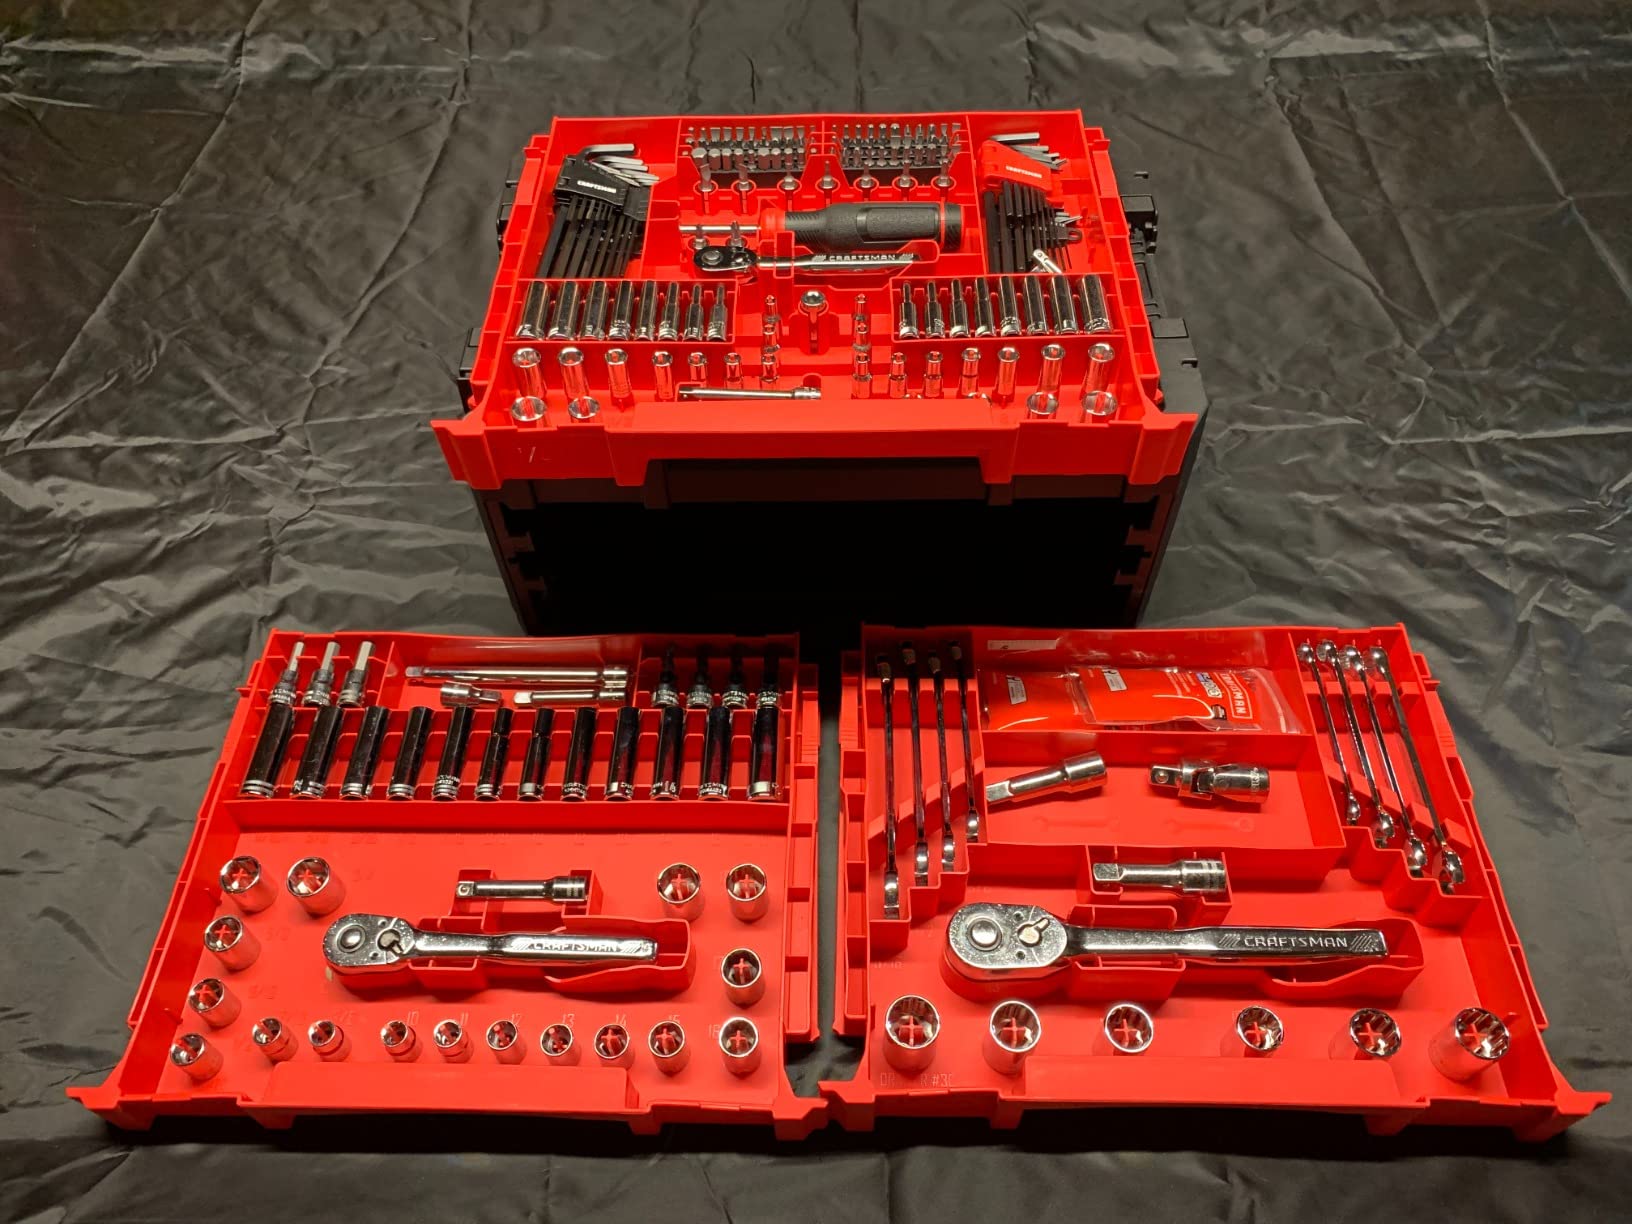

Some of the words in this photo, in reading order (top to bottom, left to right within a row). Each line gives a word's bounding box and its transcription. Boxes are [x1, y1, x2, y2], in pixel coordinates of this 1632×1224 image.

[829, 254, 896, 263] CRAFTSMAN
[531, 940, 620, 953] CRAFTSMAN
[1244, 936, 1349, 949] CRAFTSMAN
